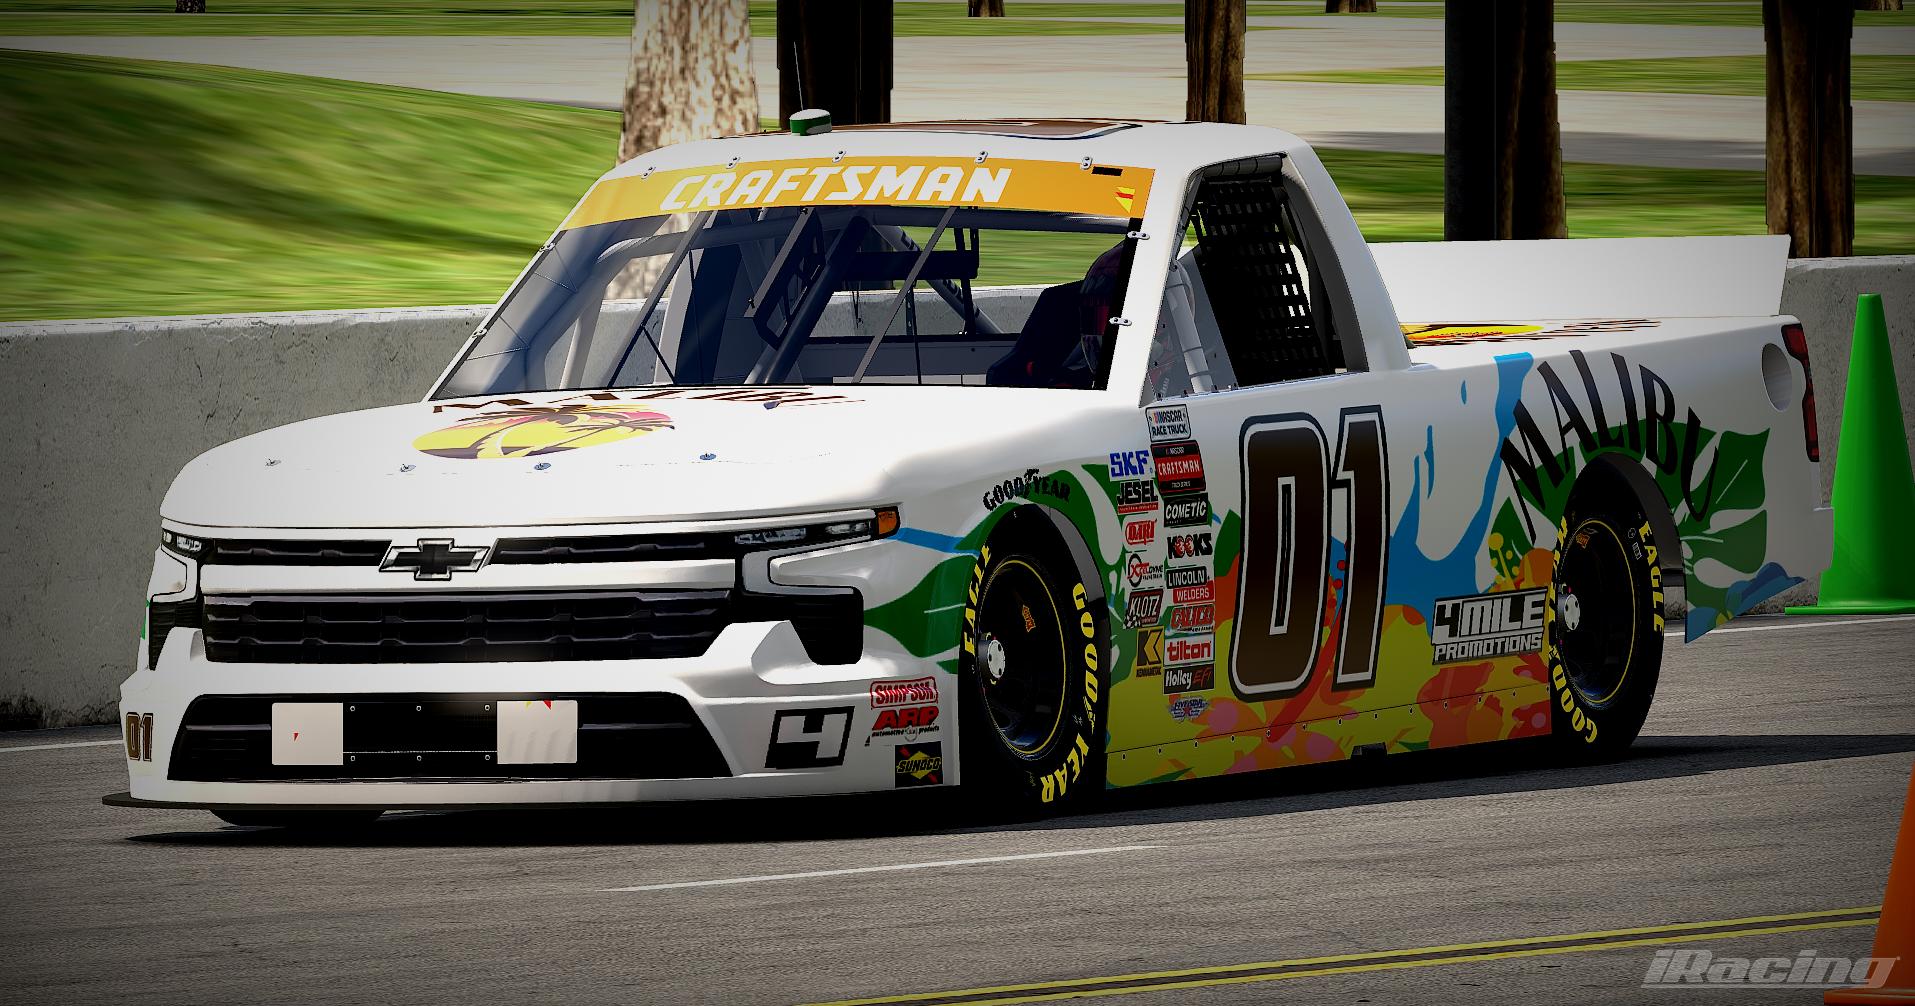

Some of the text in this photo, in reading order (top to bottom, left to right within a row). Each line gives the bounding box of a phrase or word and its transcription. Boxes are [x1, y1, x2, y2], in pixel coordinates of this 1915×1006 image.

[660, 165, 1011, 211] CRAFTSMAN
[1155, 410, 1183, 424] NASCAR
[1152, 423, 1187, 437] RACE TRUCK
[1500, 349, 1720, 546] MALIBU
[1110, 450, 1149, 478] SKF
[1157, 459, 1201, 477] CRAFTSMAN
[982, 468, 1071, 512] GOODYEAR
[1116, 479, 1158, 506] JESEL
[1165, 501, 1207, 521] COMETIC
[1228, 404, 1390, 703] 01
[1167, 569, 1206, 587] LINCOLN
[1638, 520, 1665, 633] EAGLE
[1129, 595, 1161, 618] KLOTZ
[1176, 588, 1210, 601] WELDERS
[1167, 640, 1211, 662] tilton
[1434, 633, 1543, 662] PROMOTIONS
[1165, 669, 1192, 689] Holley
[874, 680, 936, 704] SIMPSON
[871, 705, 940, 731] ARP
[125, 711, 153, 762] 01
[896, 756, 942, 774] SUNOCO
